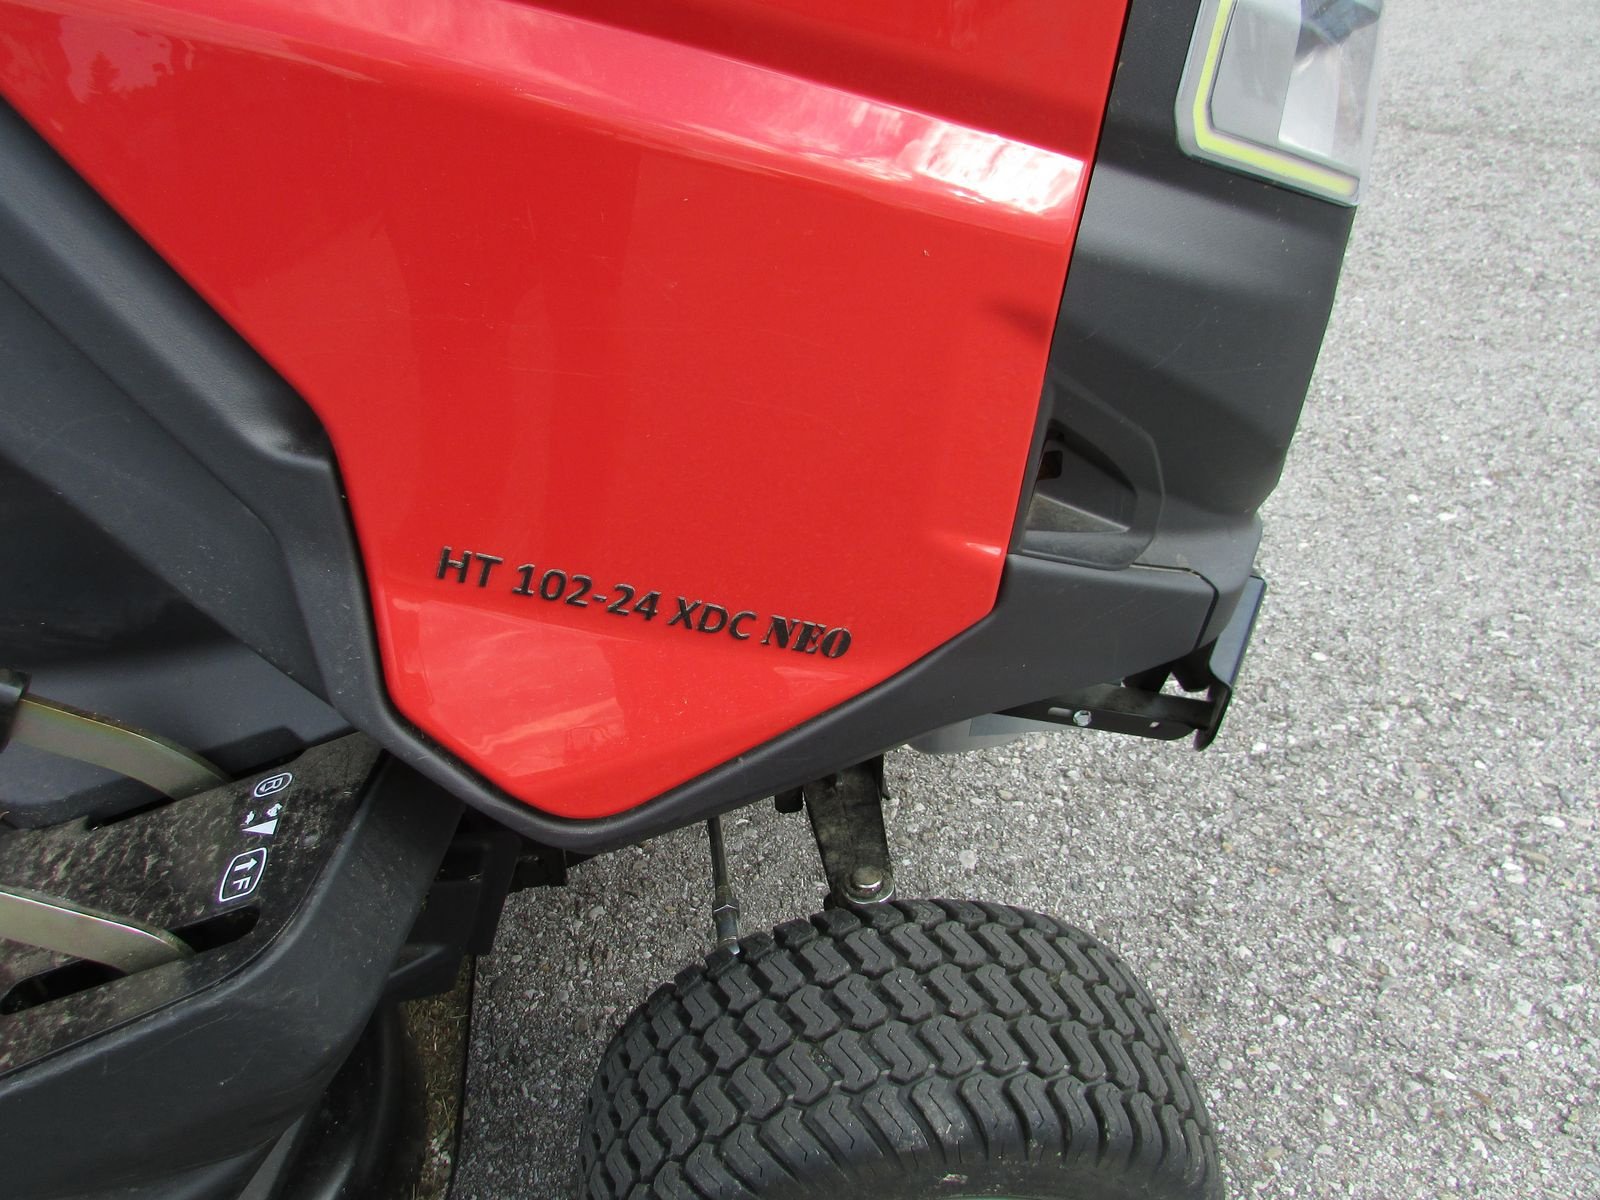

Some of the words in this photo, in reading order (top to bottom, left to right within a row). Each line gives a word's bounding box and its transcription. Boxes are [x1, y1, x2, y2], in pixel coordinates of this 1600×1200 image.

[436, 546, 504, 588] HT
[512, 563, 662, 621] 102-24
[667, 596, 758, 640] XDC
[761, 615, 852, 658] NEO
[233, 876, 252, 890] F
